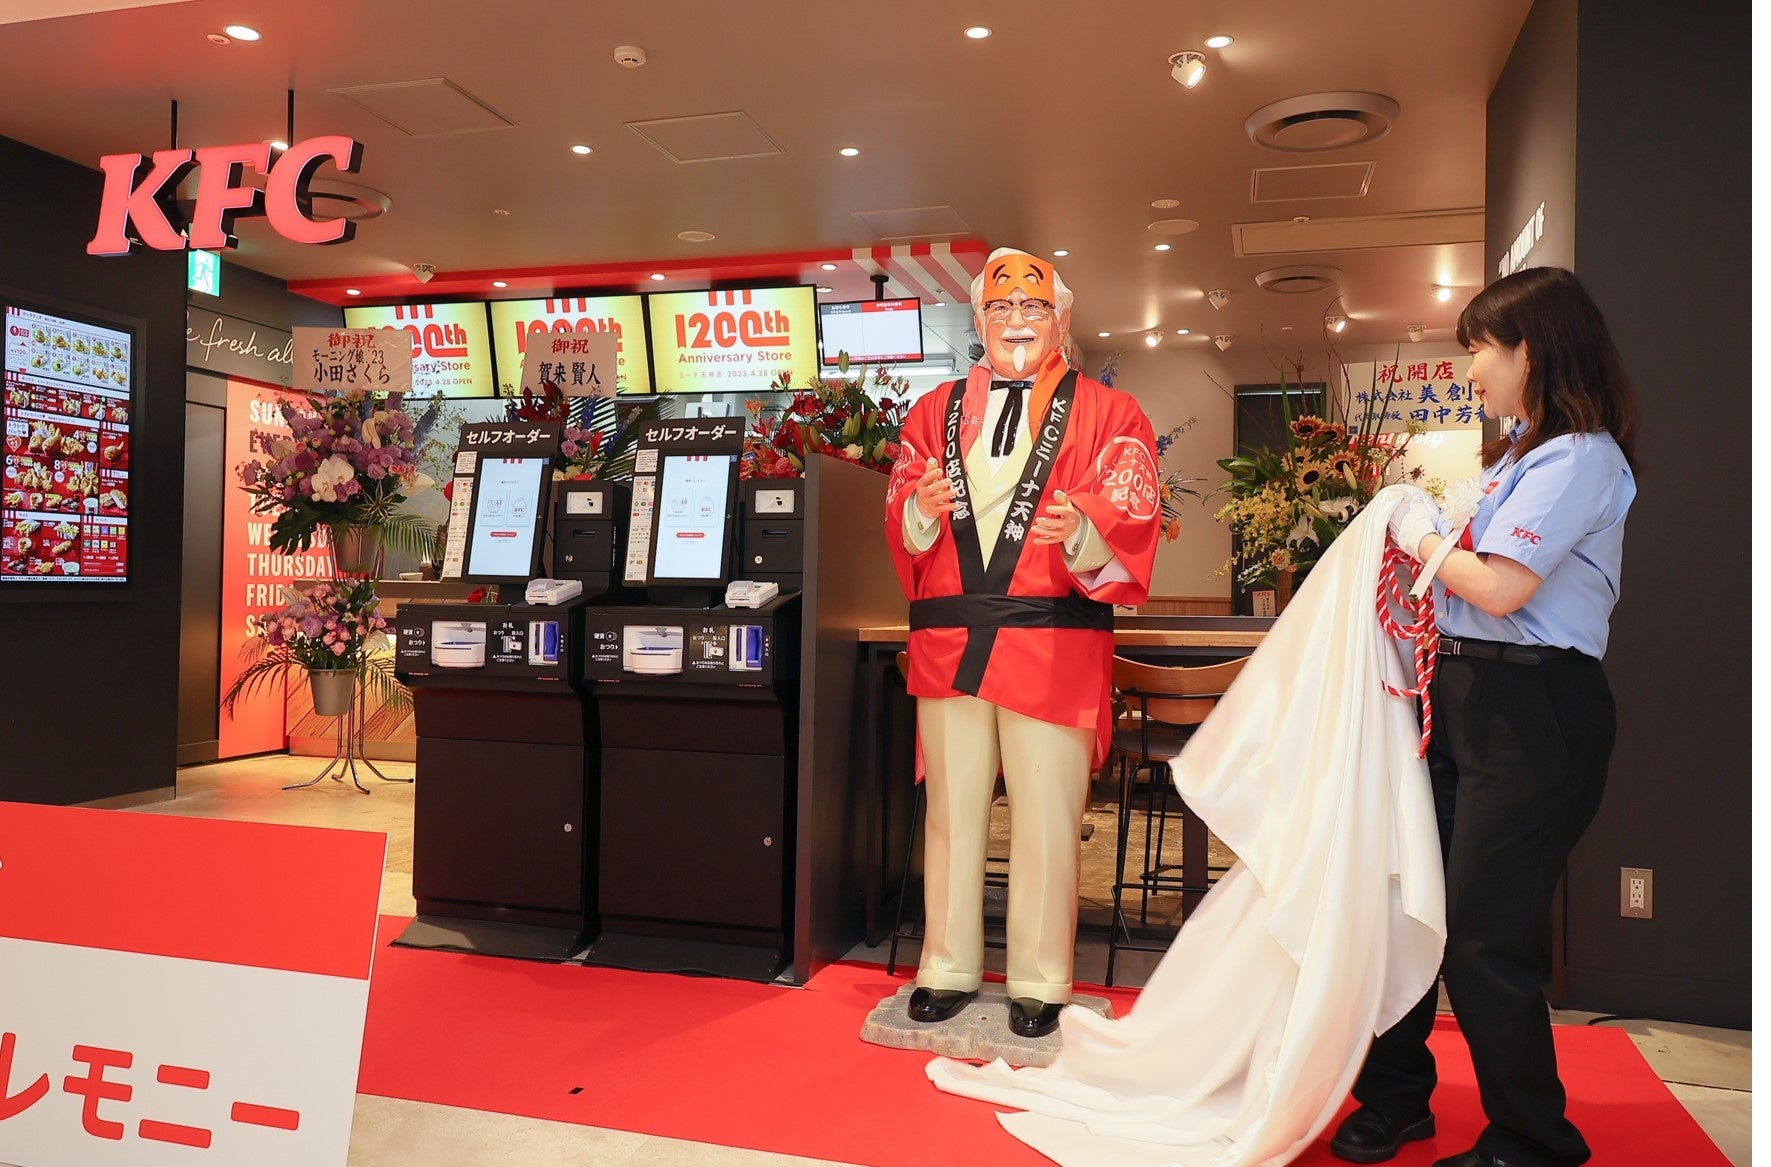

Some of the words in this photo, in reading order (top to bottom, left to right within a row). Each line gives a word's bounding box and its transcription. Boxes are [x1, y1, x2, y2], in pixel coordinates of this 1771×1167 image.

[87, 136, 356, 256] KFC
[675, 310, 790, 349] 1200th
[200, 318, 264, 362] fresh
[327, 332, 376, 349] 御祝
[551, 338, 590, 354] 御祝
[678, 352, 753, 363] Anniversary
[757, 350, 792, 361] Store
[314, 362, 390, 384] 小田さくら
[440, 361, 471, 371] Store
[1377, 360, 1455, 384] 祝開店
[452, 377, 473, 386] OPEN
[1416, 382, 1473, 404] 美創
[465, 429, 551, 446] セルフオーダー
[645, 424, 737, 442] セルフオーダー
[1123, 446, 1146, 462] KFC
[54, 459, 60, 470] 8
[1510, 526, 1542, 546] KFC
[245, 583, 294, 607] FRID
[600, 643, 615, 651] おつり
